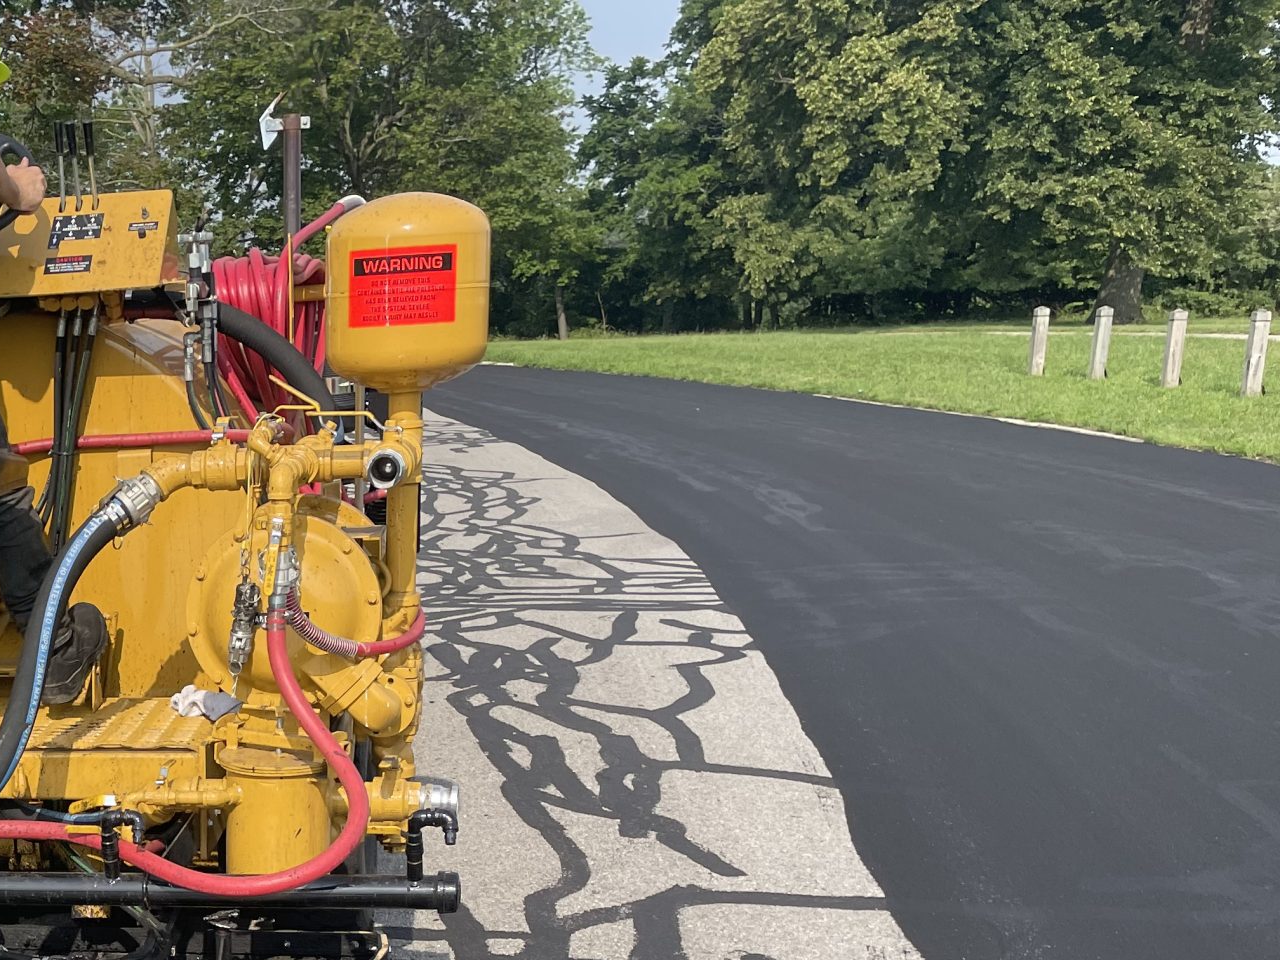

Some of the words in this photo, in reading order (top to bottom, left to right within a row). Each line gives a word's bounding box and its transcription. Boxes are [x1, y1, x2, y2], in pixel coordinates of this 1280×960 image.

[364, 256, 443, 273] WARNING
[392, 278, 417, 286] REMOVE
[357, 287, 388, 296] CONTAINER
[417, 284, 445, 293] PRESSURE
[365, 297, 377, 305] HAS
[392, 294, 419, 303] RELIEVED
[420, 293, 437, 301] FROM
[403, 312, 417, 320] MAY
[417, 311, 439, 319] RESULT
[48, 575, 64, 605] WATER
